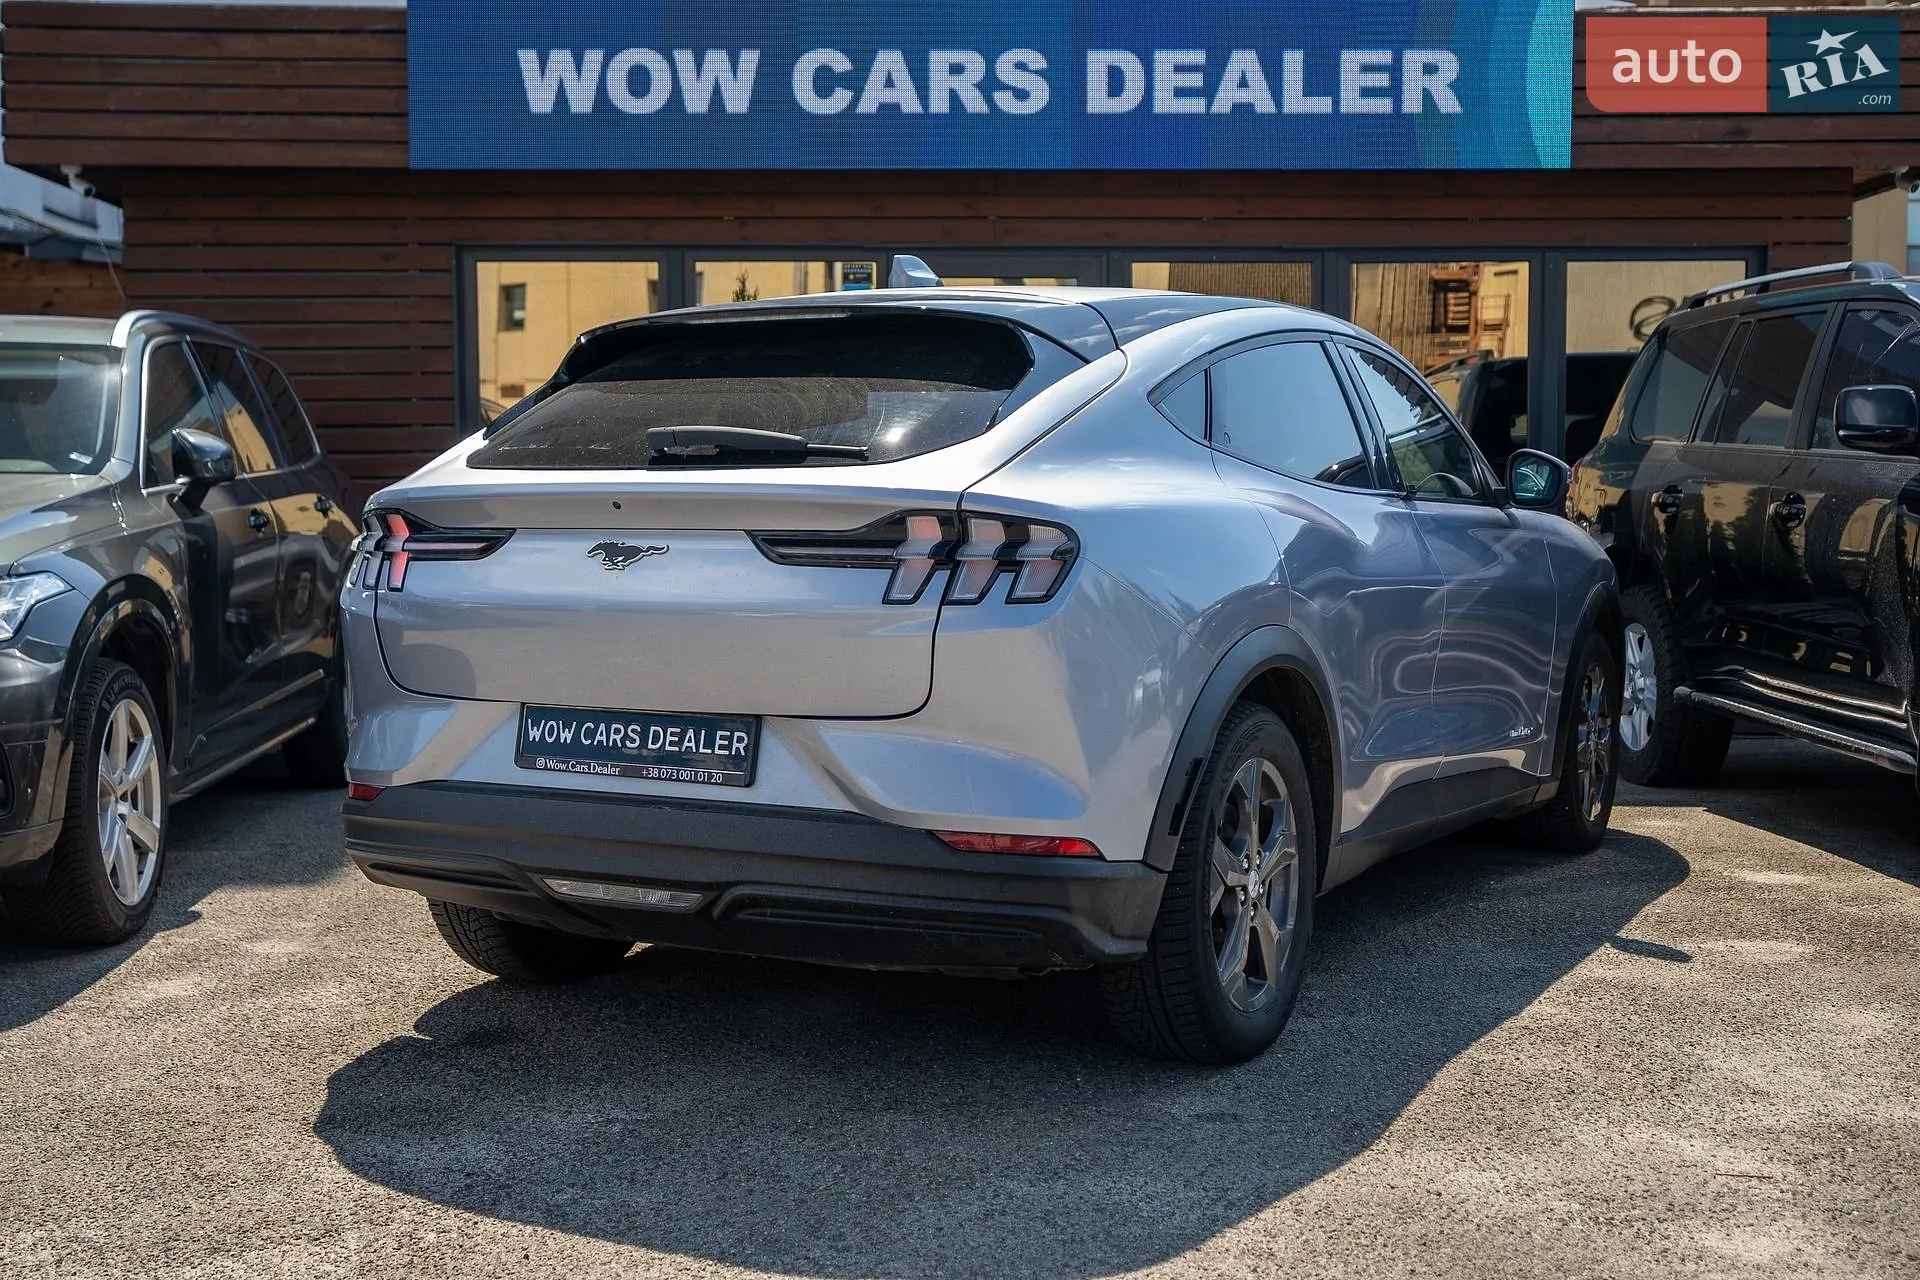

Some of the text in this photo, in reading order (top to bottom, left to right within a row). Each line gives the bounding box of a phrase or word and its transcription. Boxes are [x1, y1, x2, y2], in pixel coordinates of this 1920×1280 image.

[517, 48, 1463, 115] WOW CARS DEALER
[527, 718, 749, 756] WOW CARS DEALER
[641, 768, 723, 783] +38 073 001 01 20
